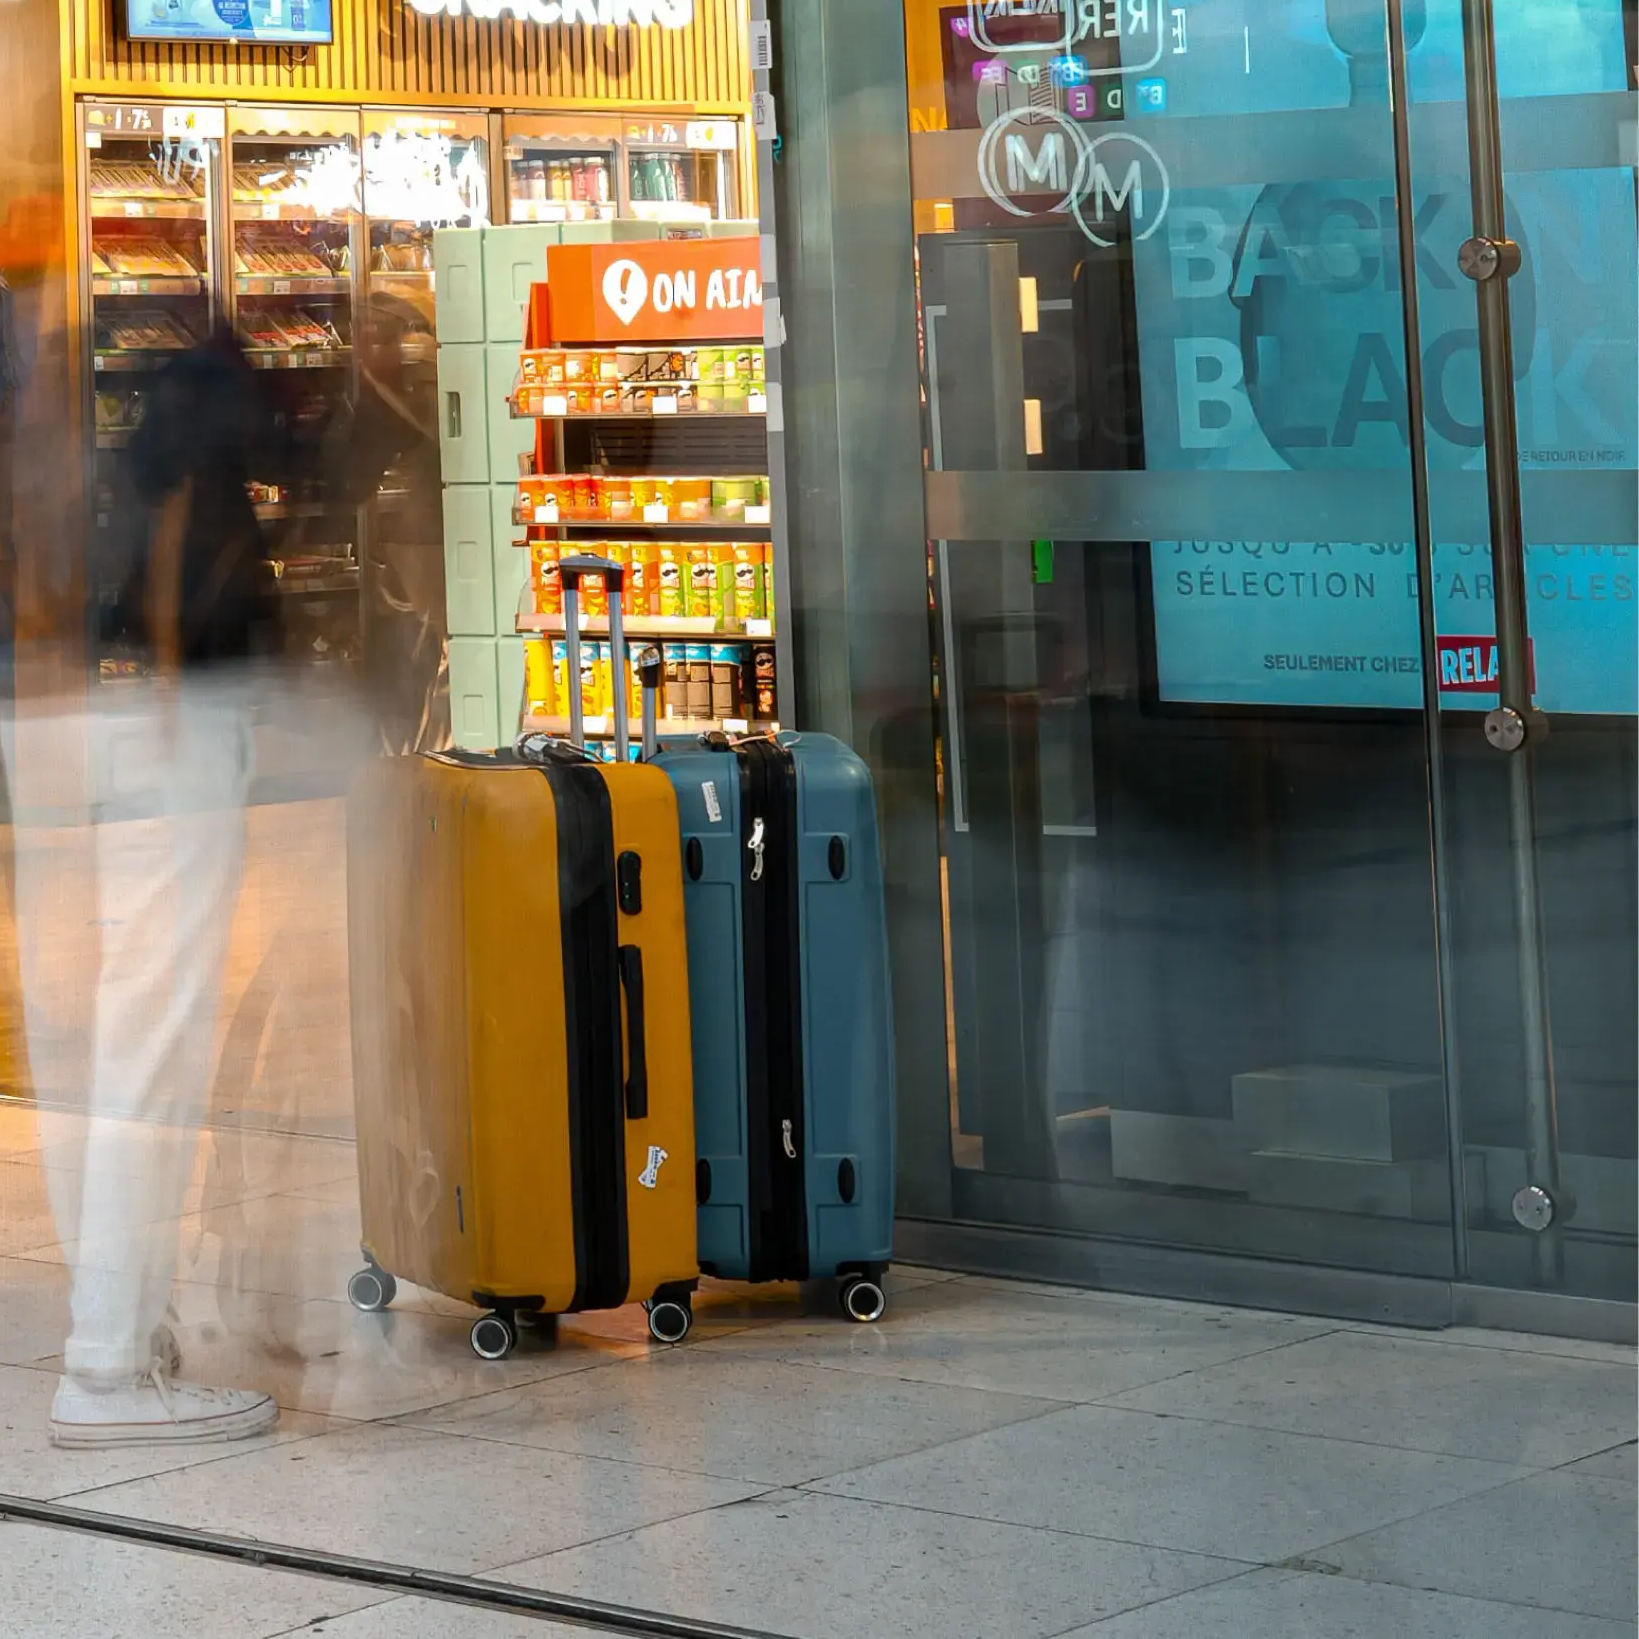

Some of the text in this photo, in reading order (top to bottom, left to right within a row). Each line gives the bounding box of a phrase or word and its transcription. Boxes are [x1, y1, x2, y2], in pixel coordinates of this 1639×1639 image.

[652, 269, 696, 313] ON
[1176, 565, 1375, 598] SÉLECTION
[1264, 654, 1420, 673] SEULEMENT CHEZ
[1440, 646, 1498, 685] RELA
